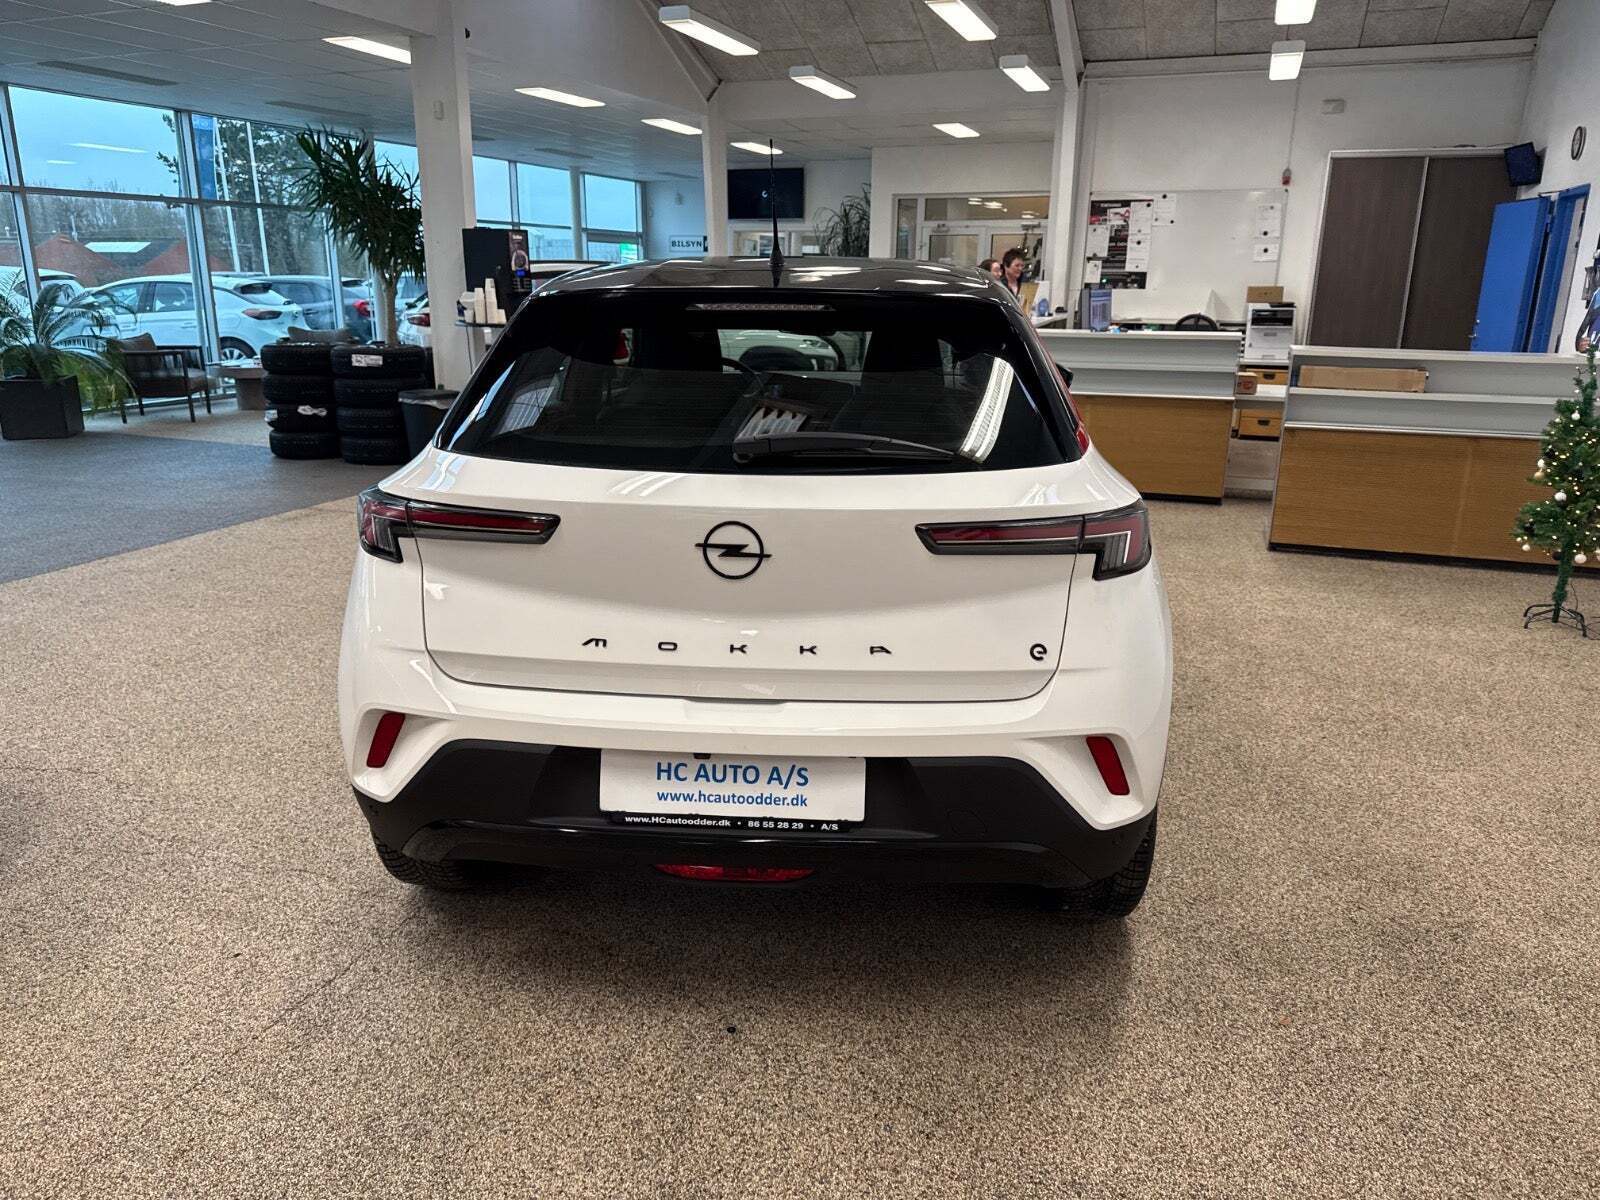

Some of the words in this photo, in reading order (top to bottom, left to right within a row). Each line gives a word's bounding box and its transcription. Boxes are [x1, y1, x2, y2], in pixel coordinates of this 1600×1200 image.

[671, 240, 702, 248] BILSYN
[582, 638, 892, 655] MOKKA
[657, 762, 688, 782] HC
[694, 763, 760, 785] AUTO
[767, 764, 809, 790] A/S
[657, 790, 808, 807] www.hcautoodder.dk
[625, 816, 731, 827] www.HCautoodder.dk
[748, 820, 760, 828] 86
[792, 822, 804, 830] 29
[821, 823, 839, 831] A/S
